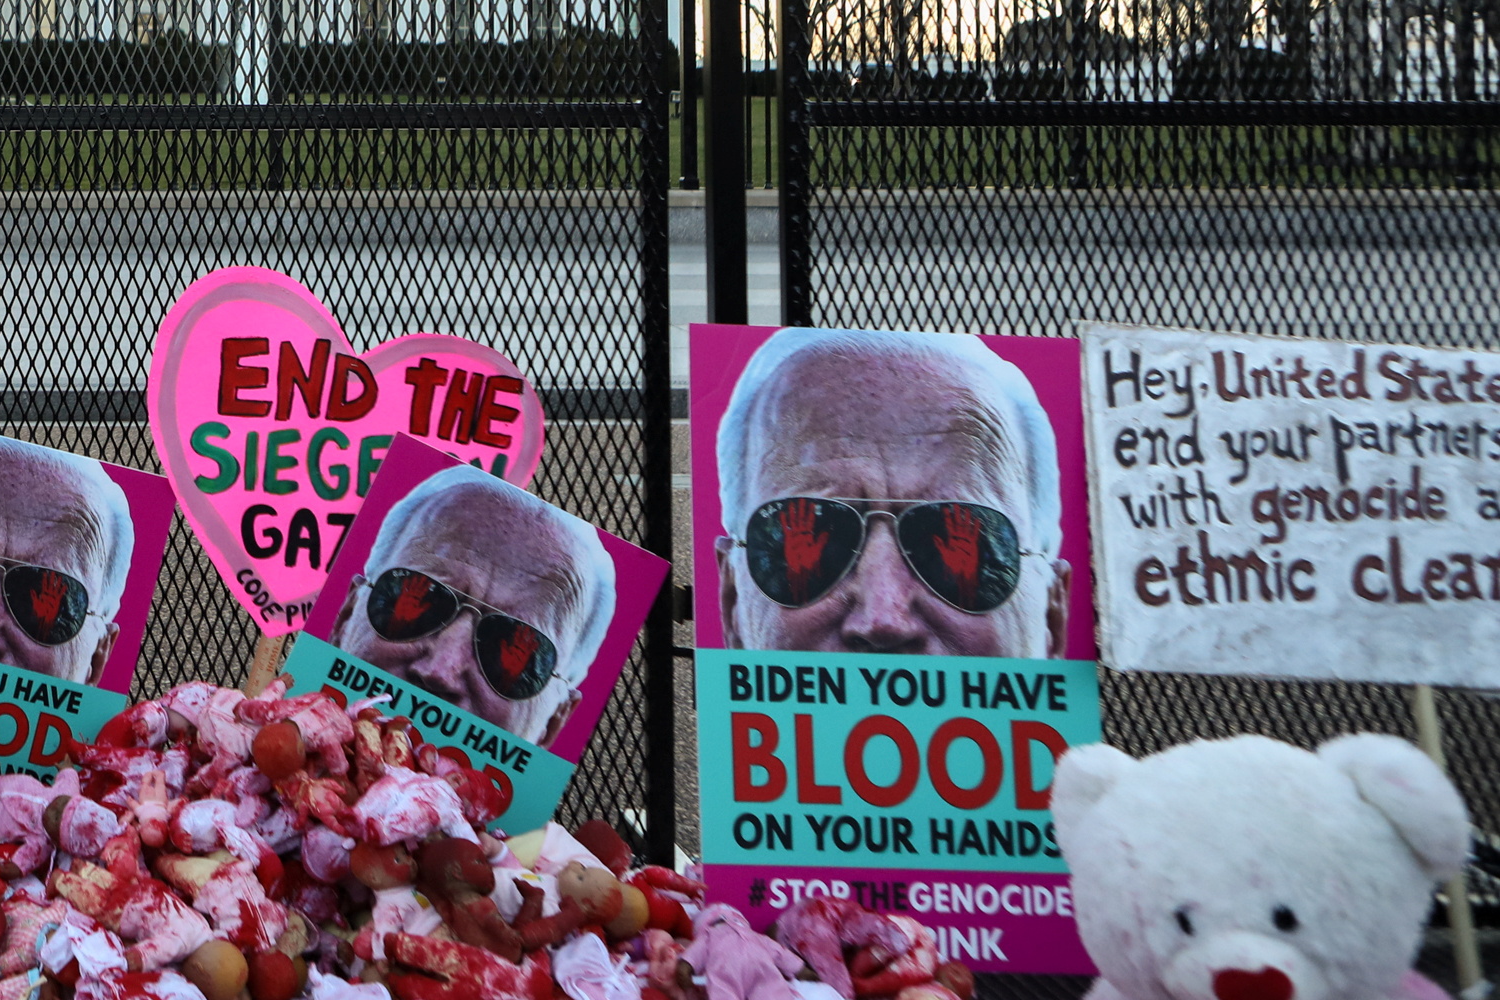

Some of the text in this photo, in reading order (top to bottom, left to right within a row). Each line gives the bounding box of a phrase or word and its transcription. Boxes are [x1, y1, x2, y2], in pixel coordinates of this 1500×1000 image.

[218, 337, 524, 449] END THE
[1211, 348, 1371, 402] United
[1114, 414, 1205, 468] end
[1219, 422, 1318, 485] your
[241, 503, 358, 575] GAZ
[1119, 469, 1233, 529] with
[1252, 465, 1448, 545] genocide
[237, 569, 314, 627] CODE PI
[1134, 529, 1317, 606] ethnic
[13, 676, 83, 714] HAVE
[327, 657, 404, 710] BIDEN
[403, 694, 463, 738] YOU
[462, 724, 533, 774] HAVE
[729, 664, 1068, 712] BIDEN YOU HAVE
[730, 711, 1069, 811] BLOOD
[733, 812, 794, 851] ON
[804, 814, 920, 856] YOUR
